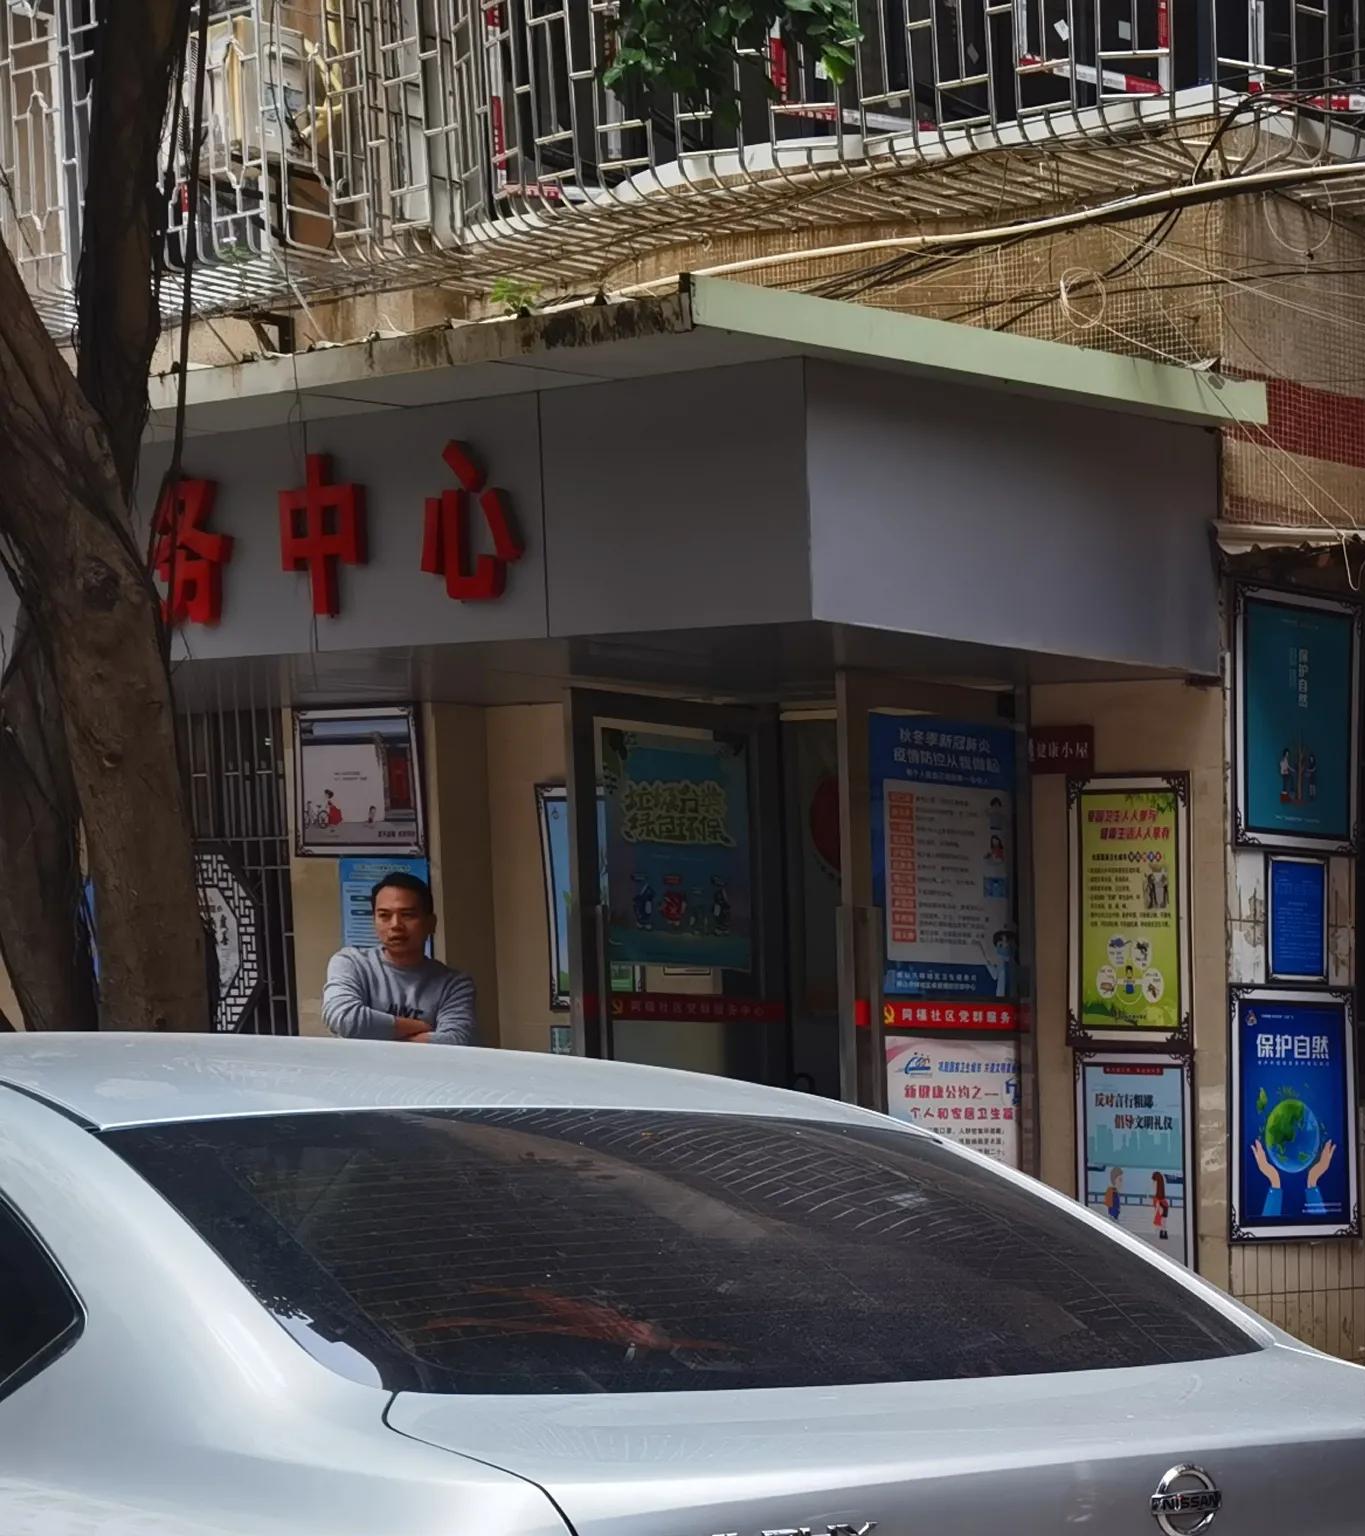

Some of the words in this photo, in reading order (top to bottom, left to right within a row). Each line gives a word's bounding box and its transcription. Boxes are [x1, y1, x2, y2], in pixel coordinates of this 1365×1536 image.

[152, 439, 526, 626] 务中心
[1256, 1033, 1330, 1060] 保护自然
[904, 1084, 999, 1100] 新健康公约之一
[1094, 1092, 1154, 1110] 反对言行粗鄙
[1114, 1114, 1173, 1131] 倡导文明礼仪
[1163, 1493, 1220, 1512] NISSAN
